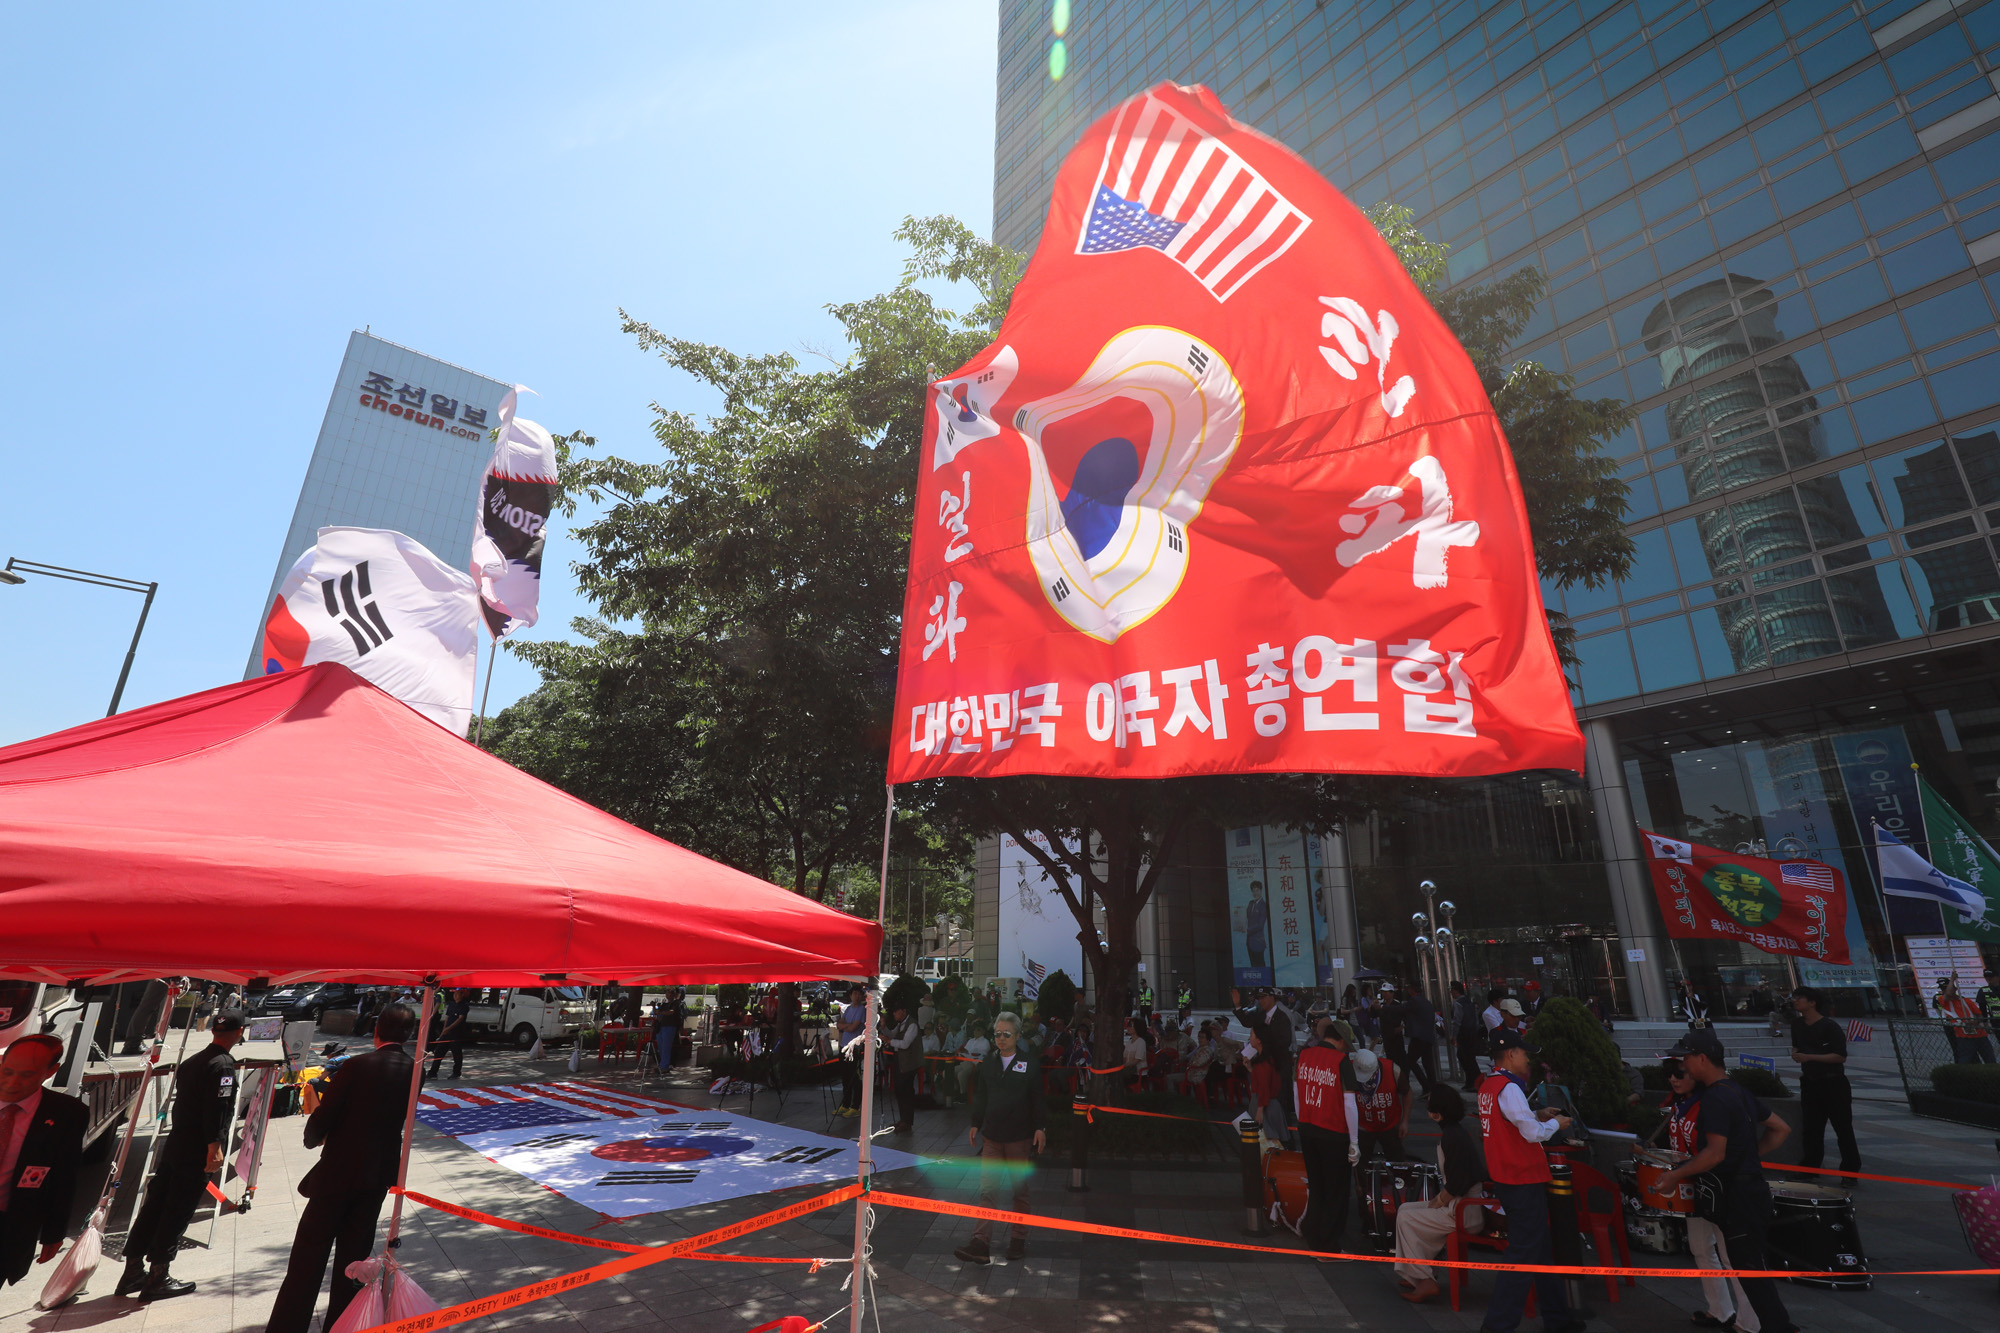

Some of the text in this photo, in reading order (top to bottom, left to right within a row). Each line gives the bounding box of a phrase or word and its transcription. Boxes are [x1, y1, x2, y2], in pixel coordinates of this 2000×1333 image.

[360, 371, 488, 430] 조선일보
[360, 393, 481, 442] chosun.com
[909, 635, 1477, 757] 대한민국 애국자 총연합
[1869, 770, 1914, 850] 우리은
[1278, 854, 1300, 957] 东和免税店
[1666, 866, 1696, 930] 하나되어
[1713, 870, 1763, 897] 종북
[672, 1240, 695, 1254] 접근금지
[722, 1226, 742, 1239] 안전제일
[756, 1216, 775, 1227] SAFETY
[776, 1212, 787, 1222] LINE
[789, 1205, 807, 1217] 추락주의
[933, 1203, 955, 1212] SAFETY
[958, 1207, 972, 1215] LINE
[396, 1315, 435, 1333] 안전제일
[463, 1298, 500, 1318] SAFETY
[502, 1292, 523, 1306] LINE
[526, 1281, 558, 1299] 추락주의
